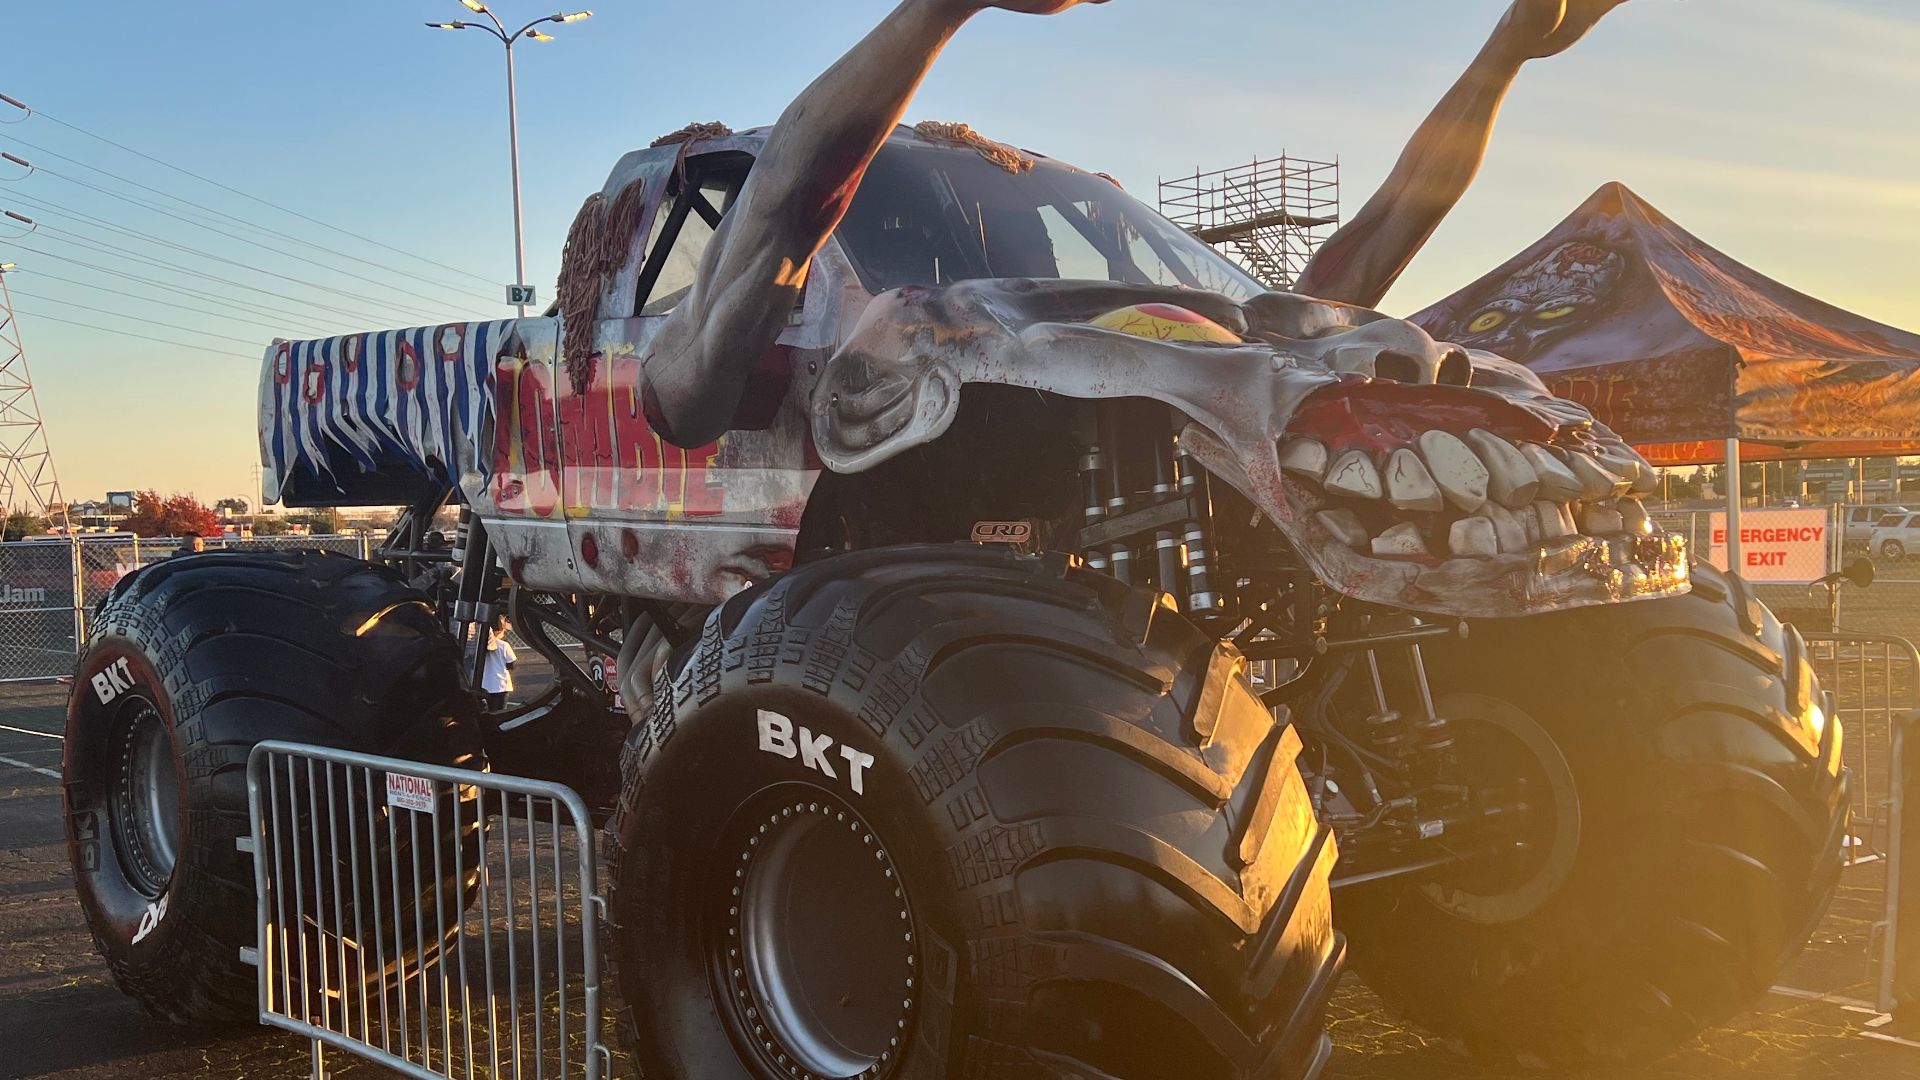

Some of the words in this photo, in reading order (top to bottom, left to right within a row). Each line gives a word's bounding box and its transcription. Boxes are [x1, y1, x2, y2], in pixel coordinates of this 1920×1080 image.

[511, 287, 534, 302] B7
[1713, 527, 1824, 544] EERGENCY
[1747, 552, 1787, 566] EXIT
[91, 656, 137, 705] BKT
[757, 708, 875, 796] BKT
[388, 774, 431, 797] NATIONAL
